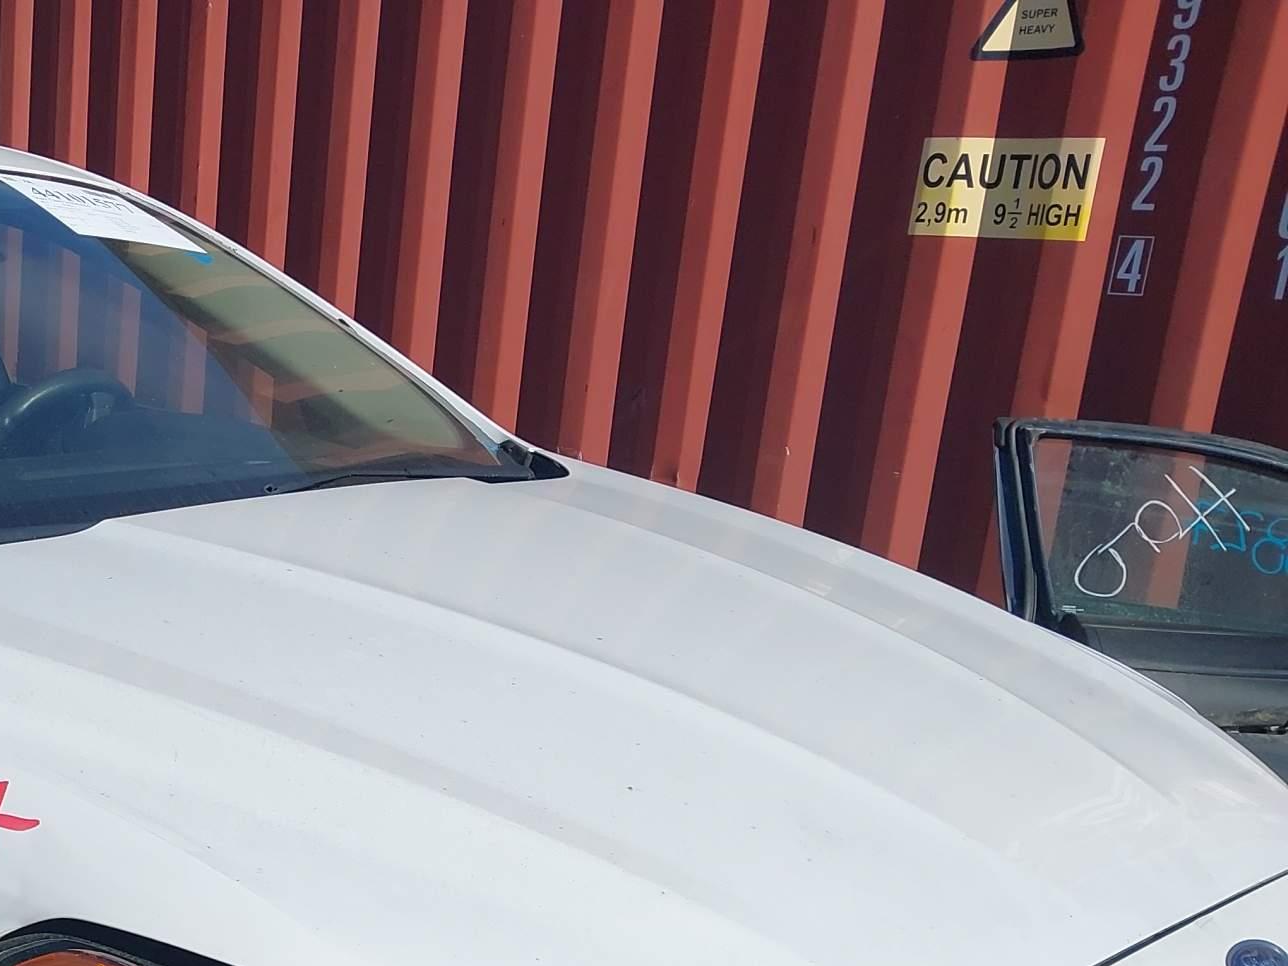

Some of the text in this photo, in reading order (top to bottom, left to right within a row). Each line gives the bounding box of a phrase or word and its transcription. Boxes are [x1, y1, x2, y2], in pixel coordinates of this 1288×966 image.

[1021, 8, 1058, 20] SUPER
[1018, 24, 1055, 36] HEAVY
[922, 152, 1092, 190] CAUTION
[914, 201, 968, 228] 2,9m
[1026, 203, 1081, 227] HIGH
[1116, 239, 1145, 292] 4
